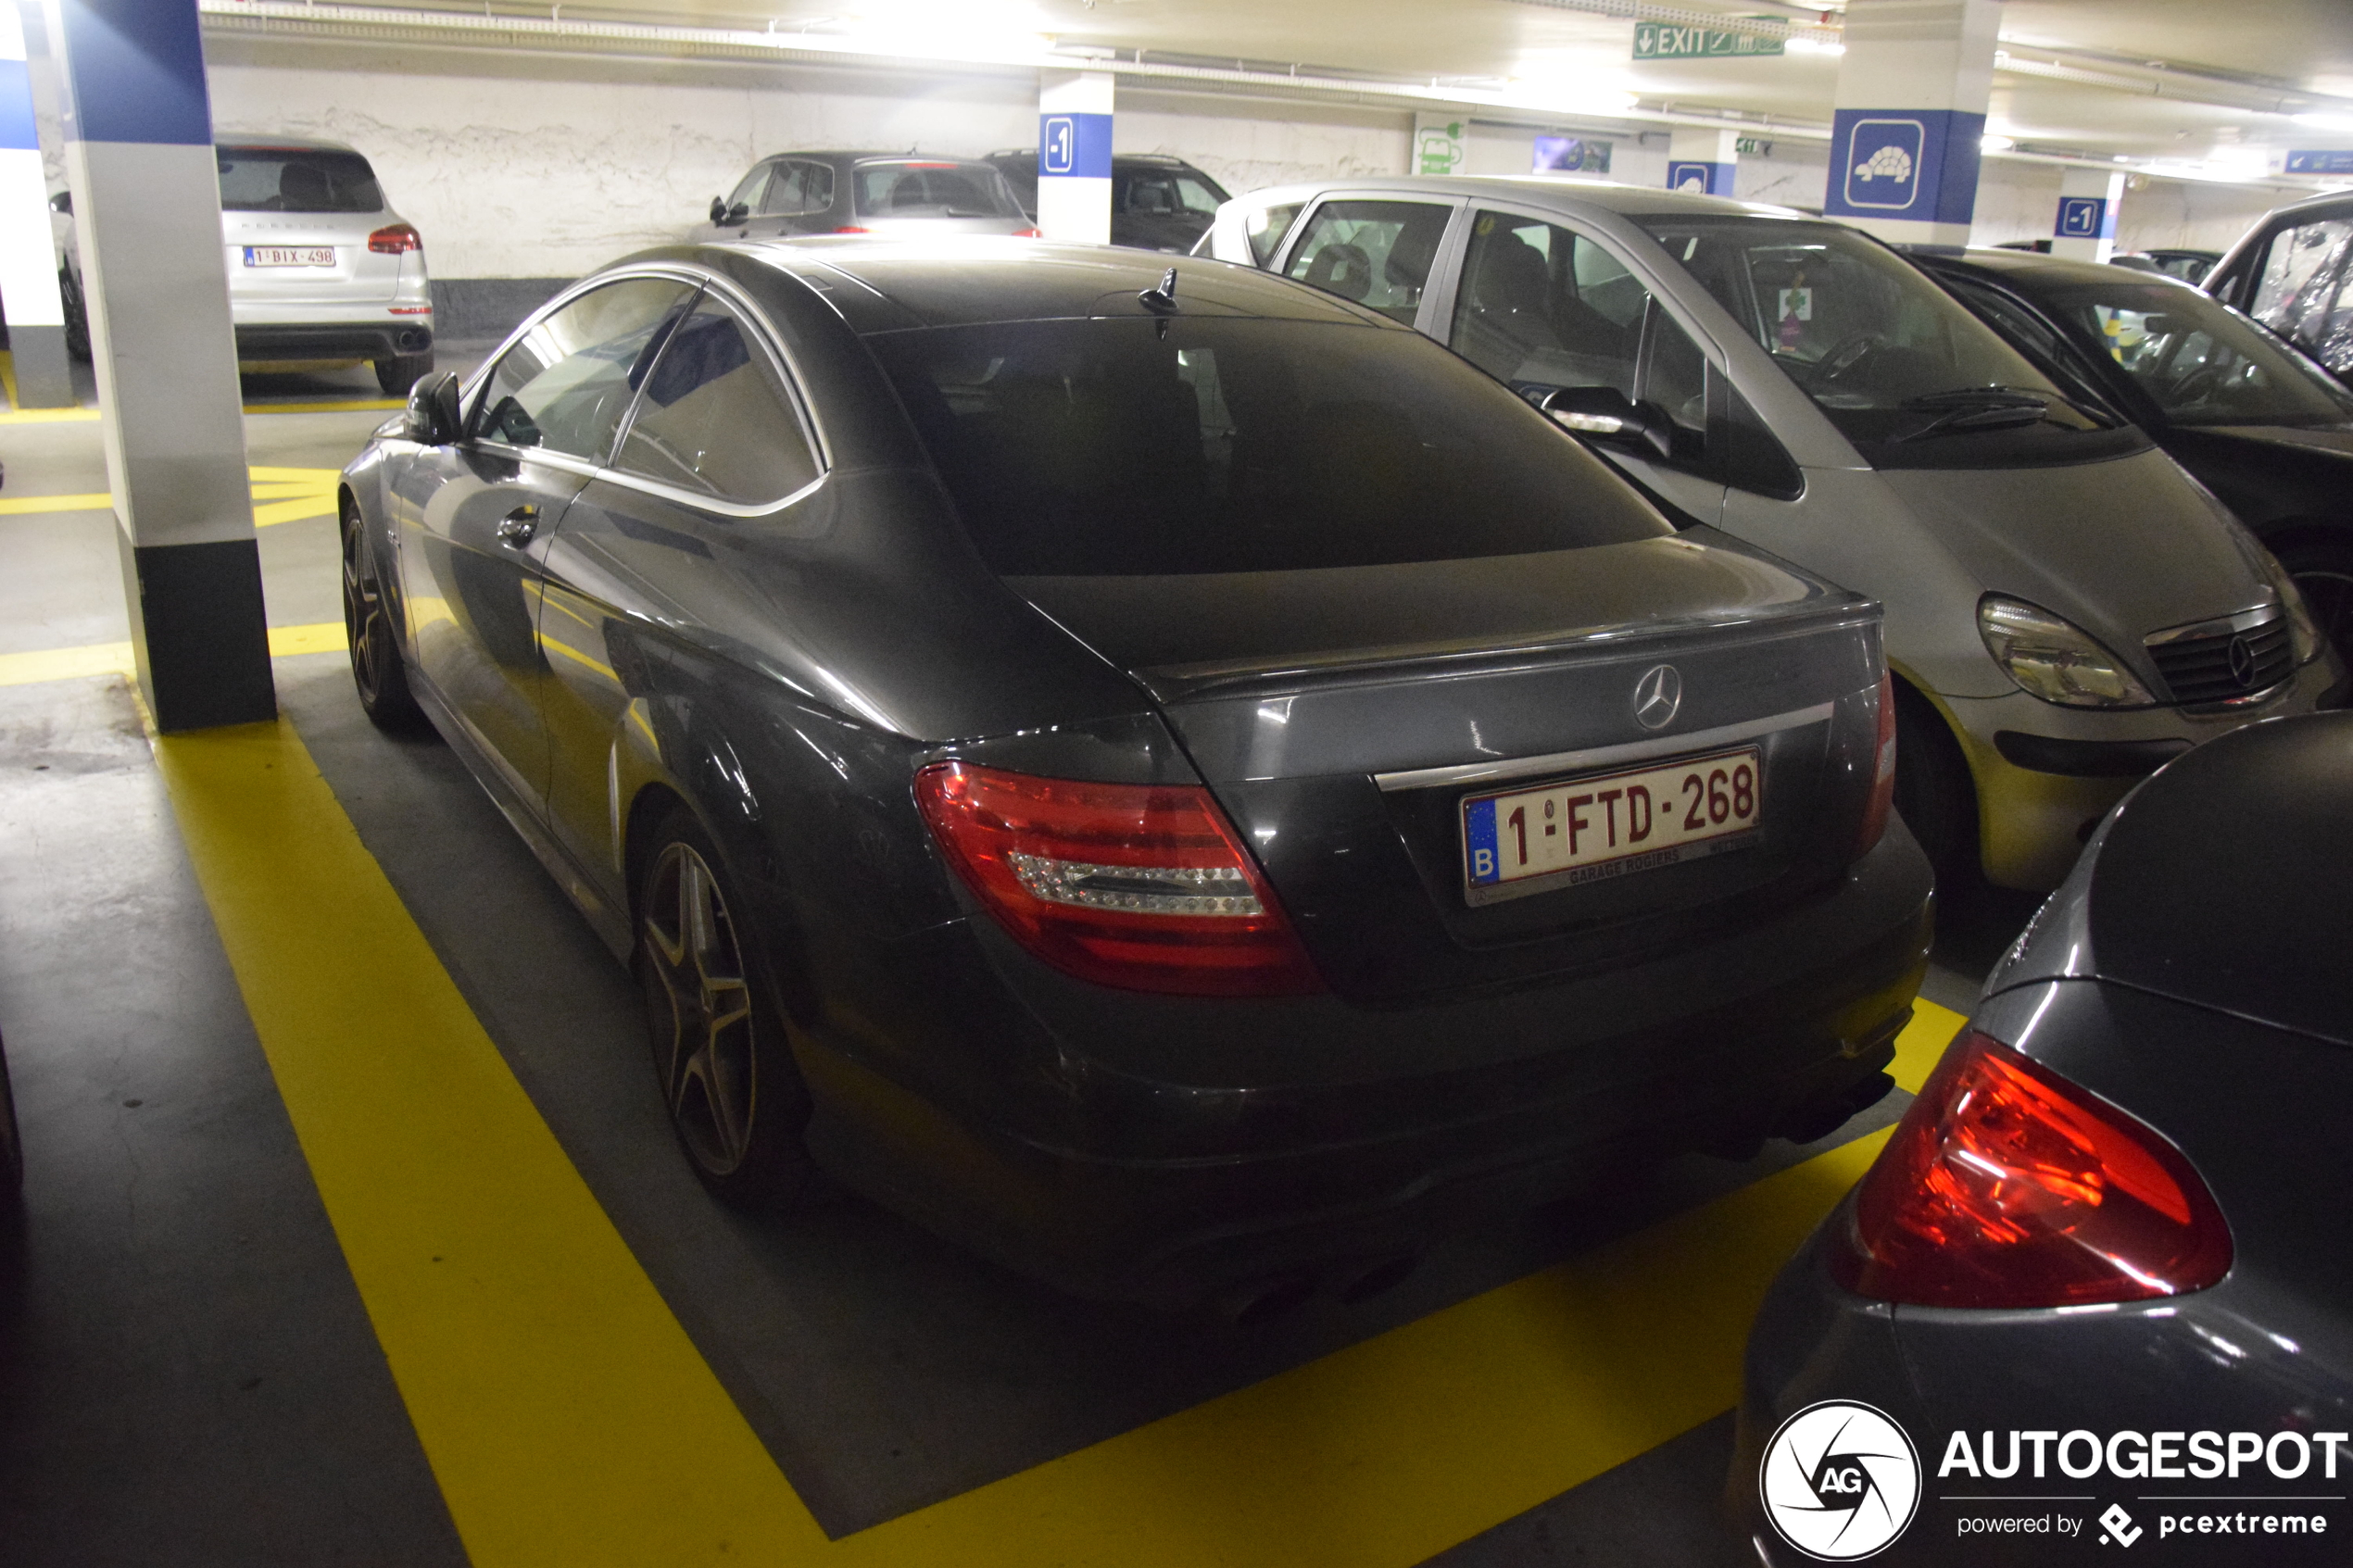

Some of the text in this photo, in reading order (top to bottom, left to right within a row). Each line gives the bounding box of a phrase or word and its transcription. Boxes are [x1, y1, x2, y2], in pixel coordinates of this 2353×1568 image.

[1657, 27, 1709, 55] EXIT
[1050, 126, 1068, 164] -1
[2069, 206, 2092, 231] -1
[1474, 847, 1494, 877] B
[1569, 860, 1622, 884] GARAGE
[1627, 847, 1681, 872] ROGIERS
